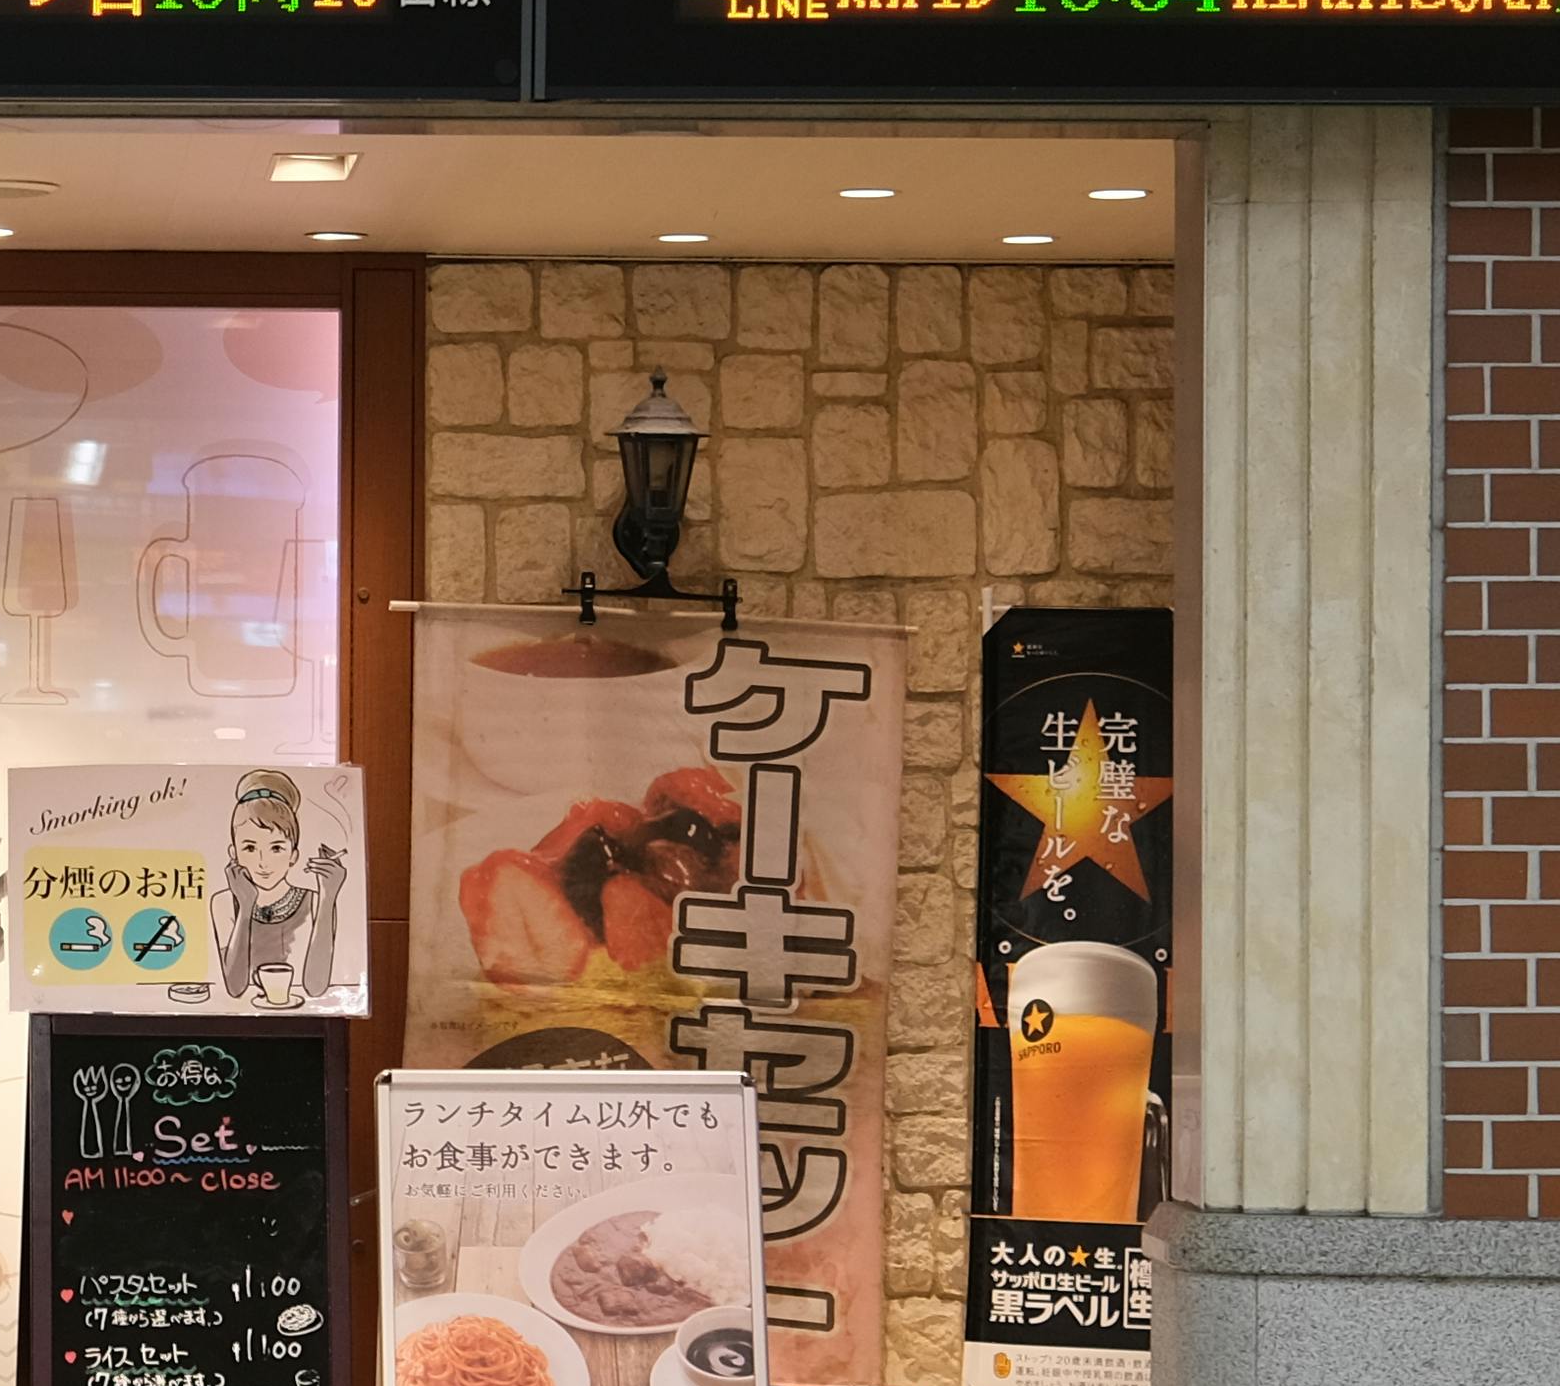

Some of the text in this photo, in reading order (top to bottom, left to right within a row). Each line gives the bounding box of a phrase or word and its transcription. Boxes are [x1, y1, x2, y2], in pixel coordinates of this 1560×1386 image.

[1097, 712, 1138, 844] 完璧な
[30, 778, 187, 836] Smorking ok!
[1039, 711, 1084, 921] 生ビールを。
[24, 865, 205, 901] 分煙のお店
[1018, 1041, 1062, 1061] SAPPORO
[157, 1061, 222, 1087] お得な
[403, 1099, 720, 1130] ランチタイム以外でも
[153, 1115, 238, 1158] Set
[402, 1141, 676, 1173] お食事ができます。
[64, 1169, 105, 1191] AM
[403, 1181, 592, 1201] お気軽にご利用ください。
[990, 1269, 1120, 1293] サッポロ生ビール
[990, 1290, 1120, 1329] 黒ラベル
